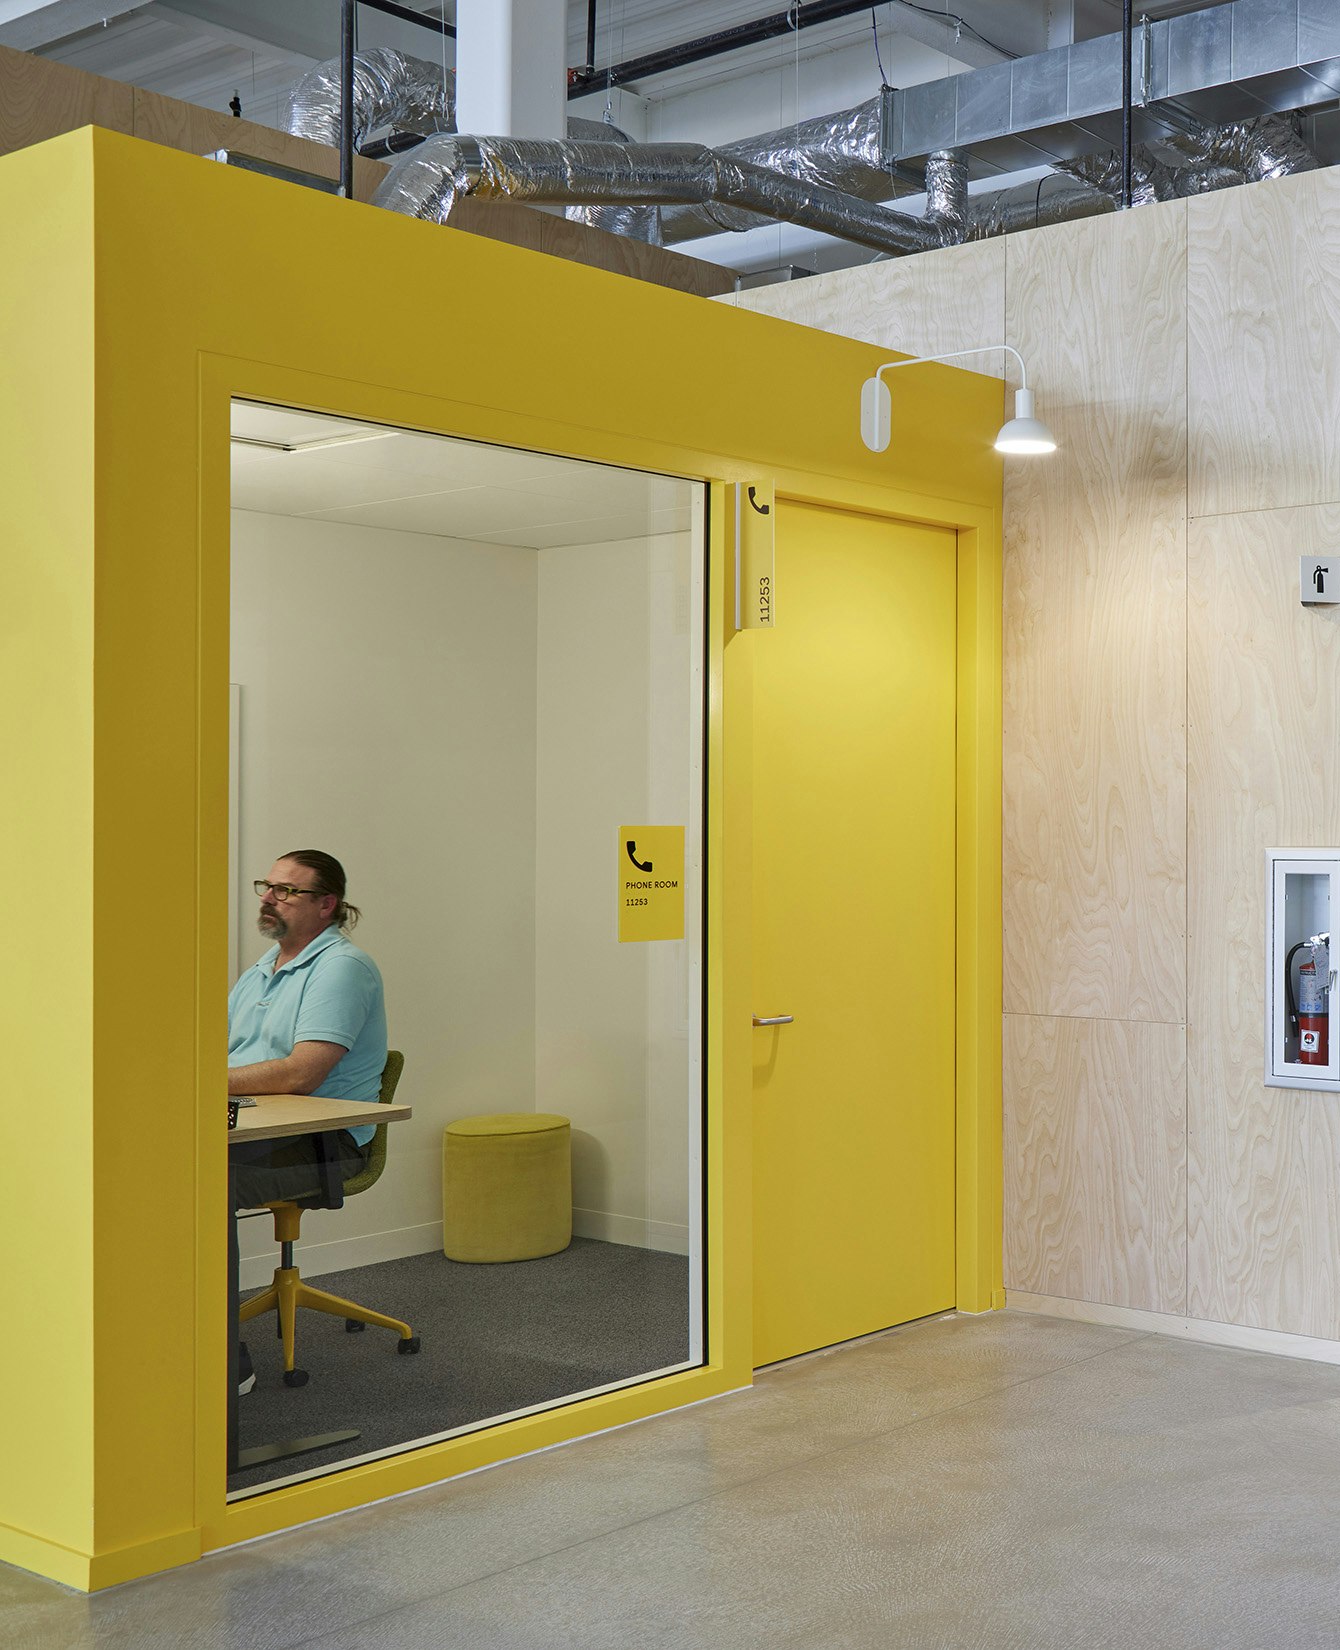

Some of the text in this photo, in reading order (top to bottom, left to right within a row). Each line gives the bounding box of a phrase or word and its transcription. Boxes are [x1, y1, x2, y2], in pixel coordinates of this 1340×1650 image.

[760, 576, 770, 623] 11253
[626, 881, 678, 889] PHONE ROOM
[626, 898, 649, 907] 11253
